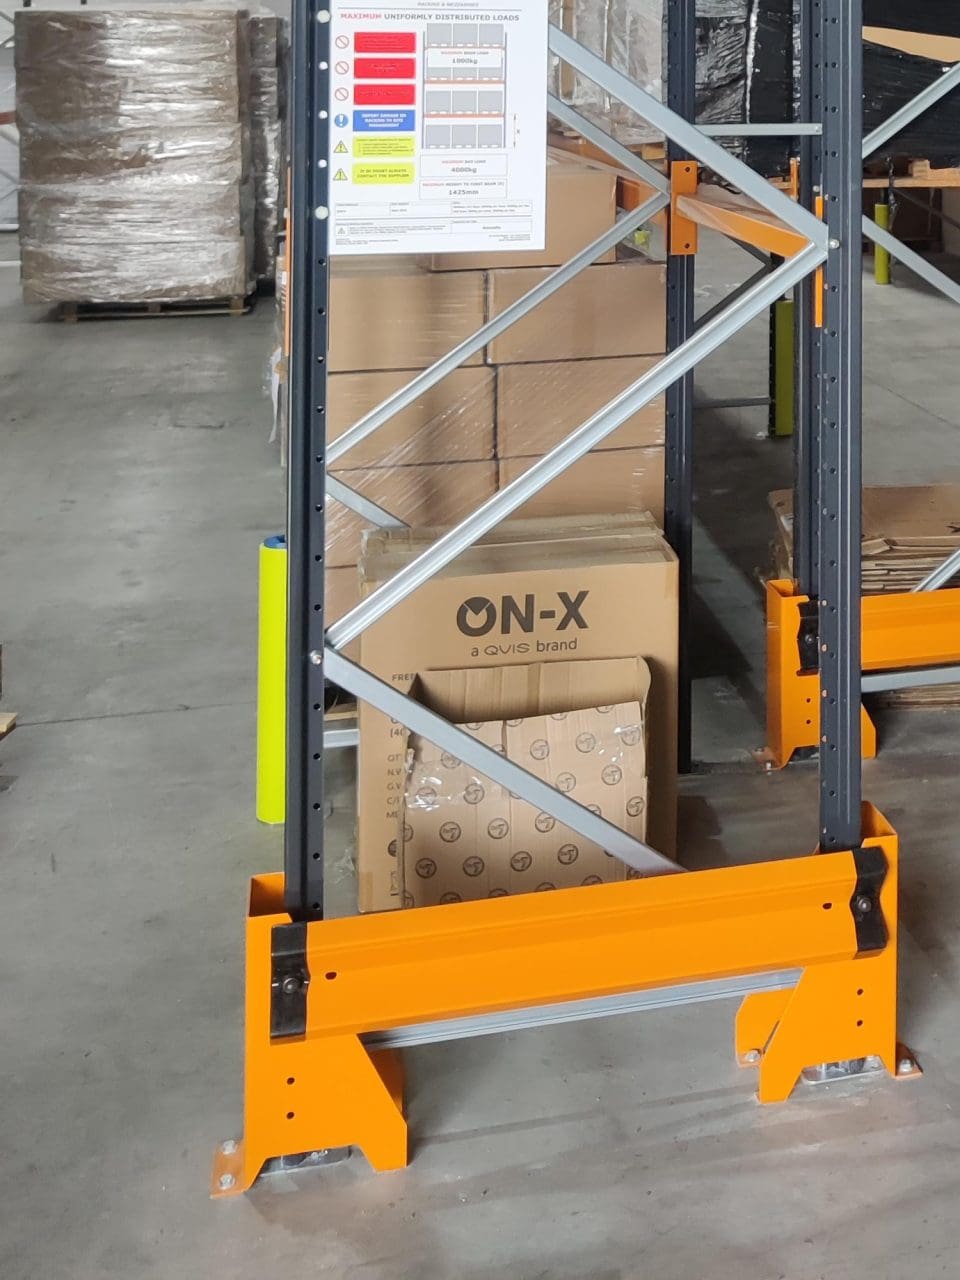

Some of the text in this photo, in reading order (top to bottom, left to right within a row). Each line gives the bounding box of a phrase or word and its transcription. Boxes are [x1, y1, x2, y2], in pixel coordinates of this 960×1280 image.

[384, 13, 434, 21] UNIFORMLY
[456, 589, 590, 637] ON-X
[470, 637, 578, 657] a QVIS brand
